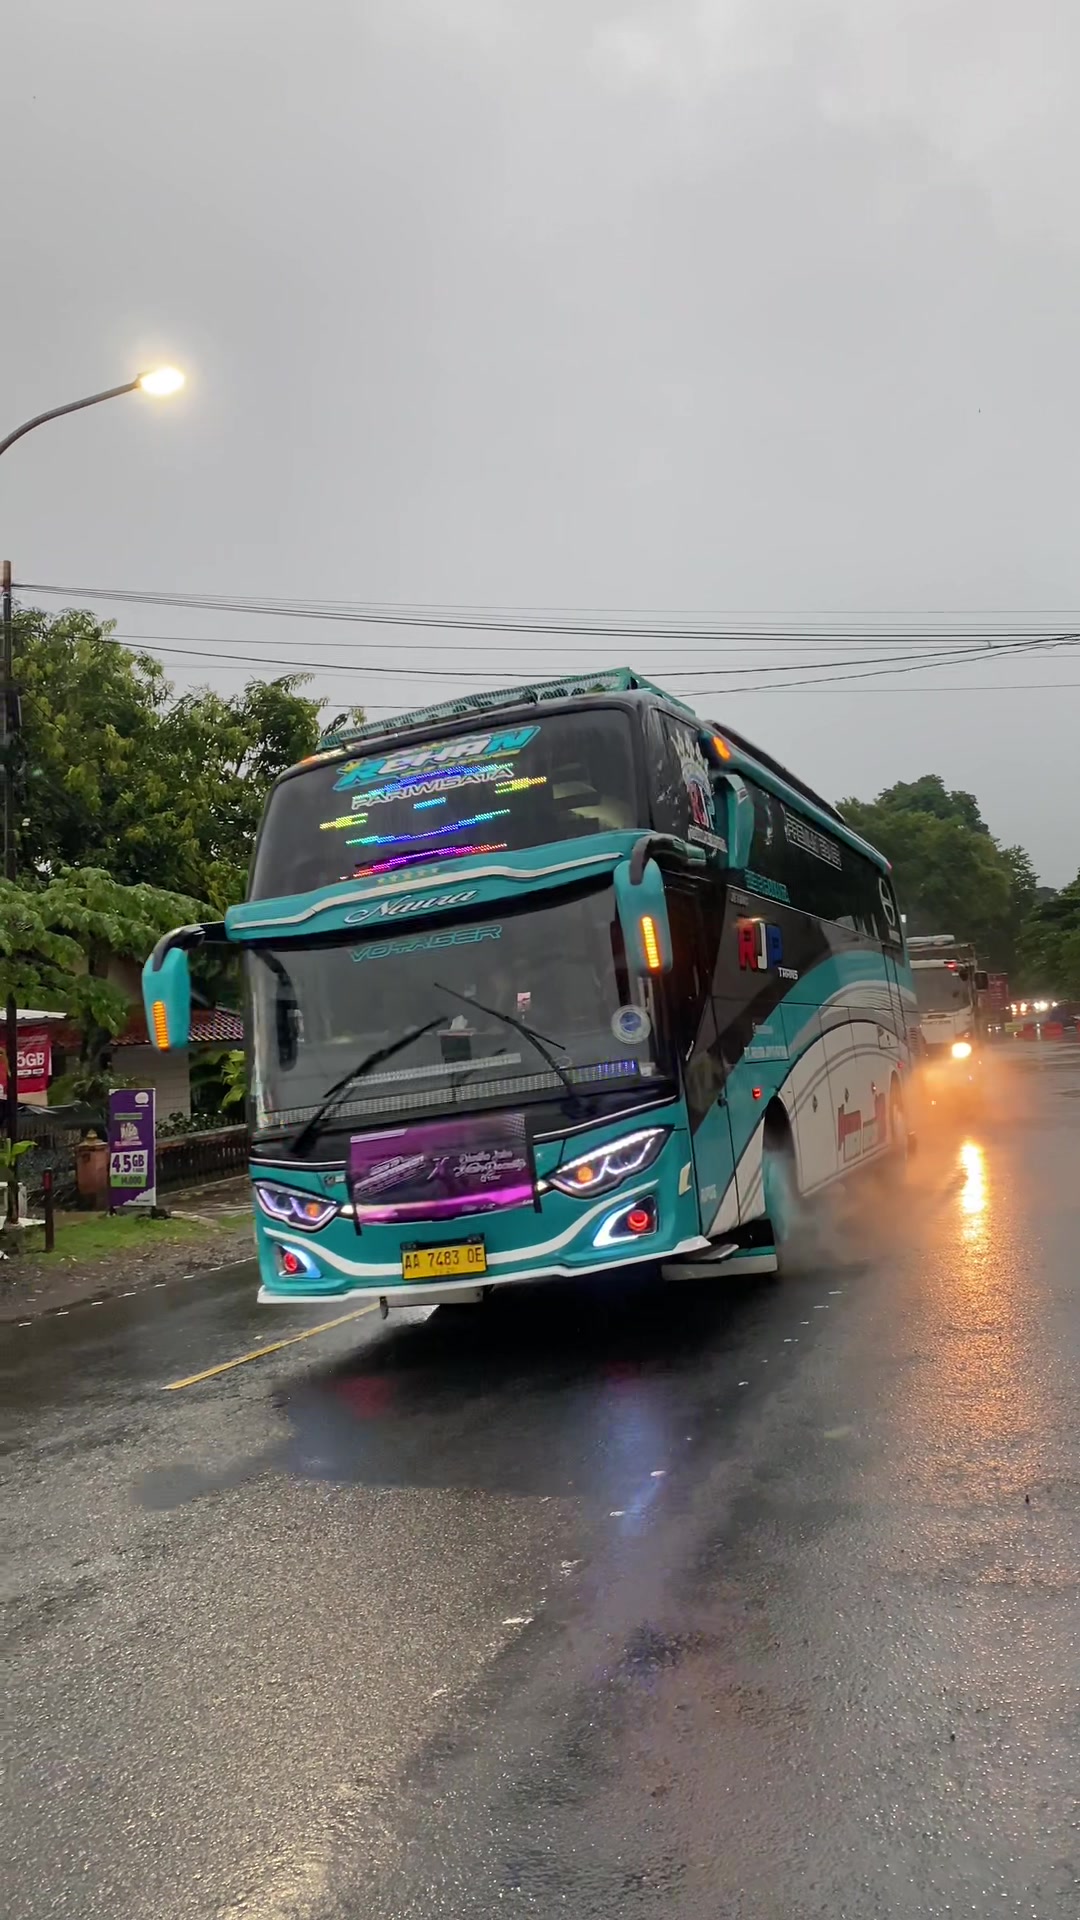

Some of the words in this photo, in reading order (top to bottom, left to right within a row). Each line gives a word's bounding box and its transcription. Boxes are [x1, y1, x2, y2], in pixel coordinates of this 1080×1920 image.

[352, 767, 514, 810] PARIWISATA
[405, 1253, 420, 1269] AA
[428, 1250, 460, 1267] 7483
